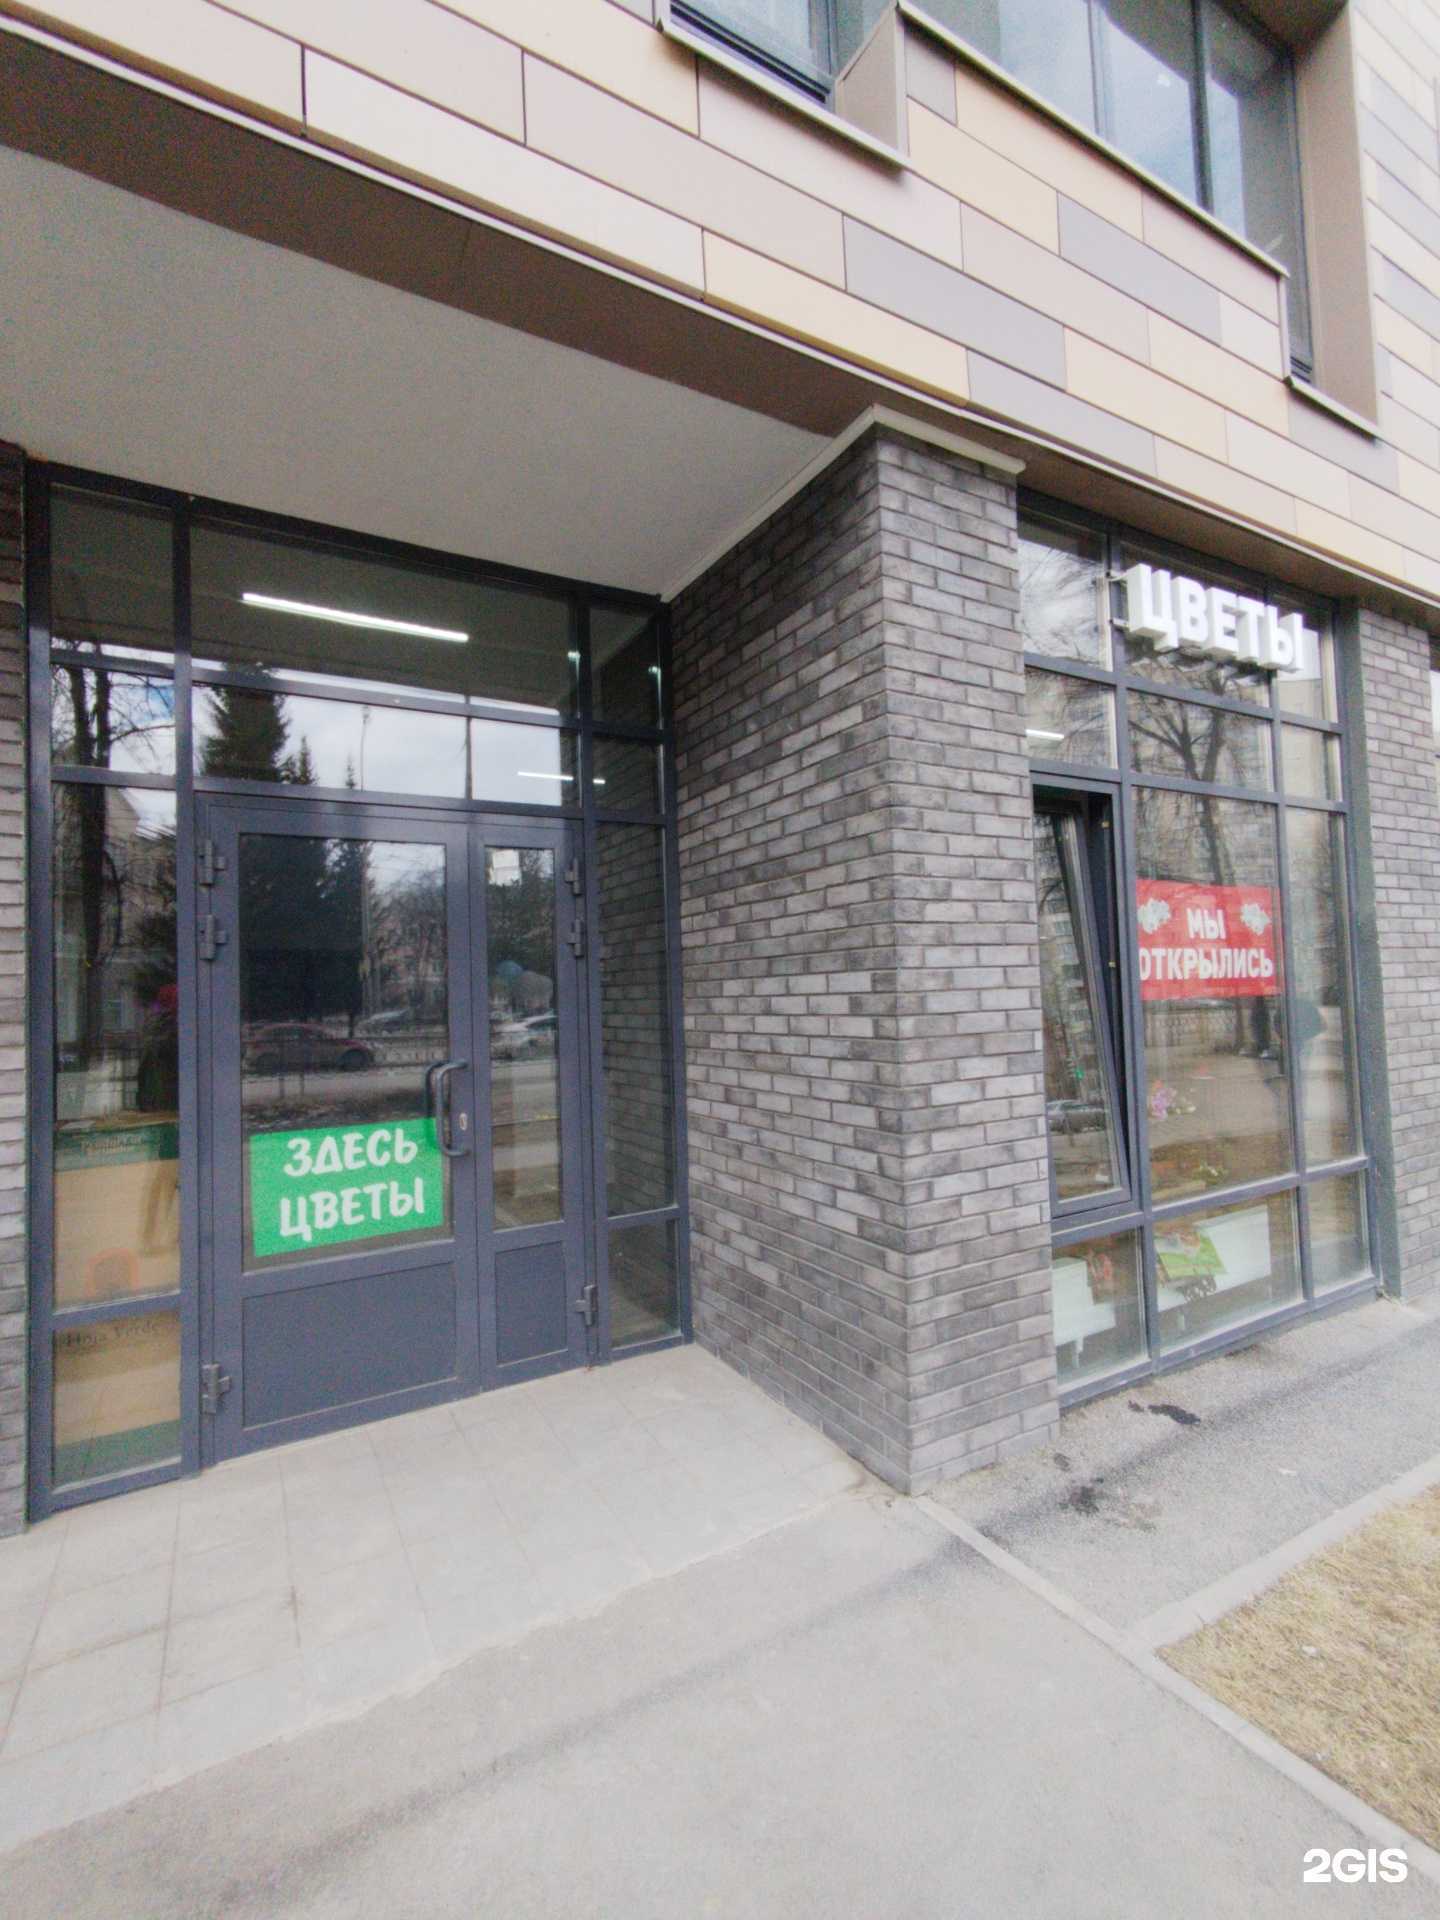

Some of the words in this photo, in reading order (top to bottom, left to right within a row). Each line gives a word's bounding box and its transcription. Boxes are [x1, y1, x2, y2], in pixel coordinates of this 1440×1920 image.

[1127, 563, 1304, 673] ЦВЕТЫ
[1186, 908, 1227, 940] МЫ
[1138, 947, 1275, 981] ОТКРЫЛИСЬ
[283, 1127, 418, 1177] ЗДЕСЬ
[280, 1176, 425, 1243] ЦВЕТЫ
